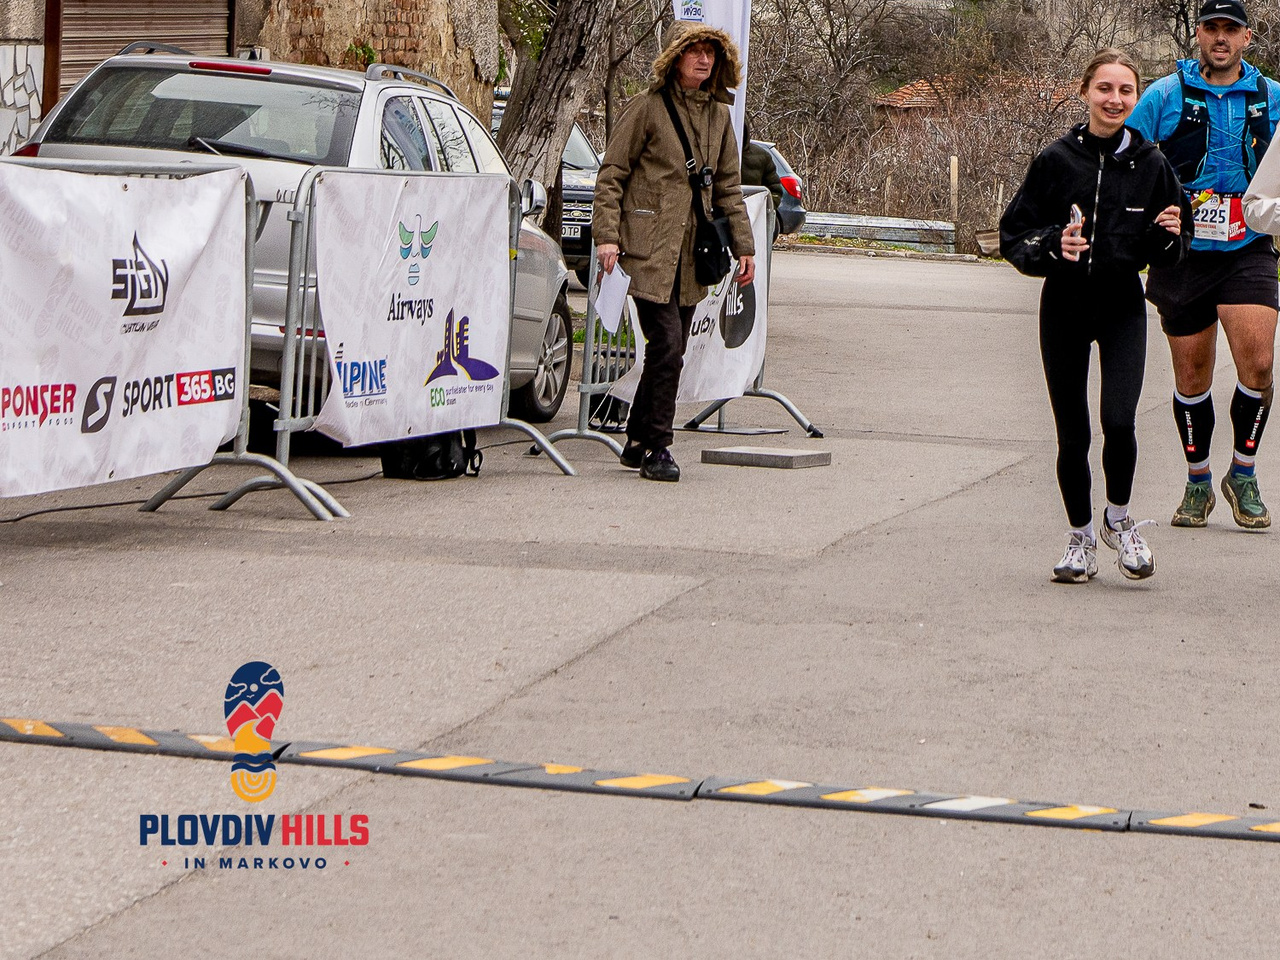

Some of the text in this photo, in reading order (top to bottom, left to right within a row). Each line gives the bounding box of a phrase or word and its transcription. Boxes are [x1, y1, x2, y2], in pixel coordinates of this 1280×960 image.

[1193, 208, 1226, 223] 2225
[387, 292, 434, 326] Airways
[122, 374, 175, 418] SPORT
[430, 387, 445, 407] ECO
